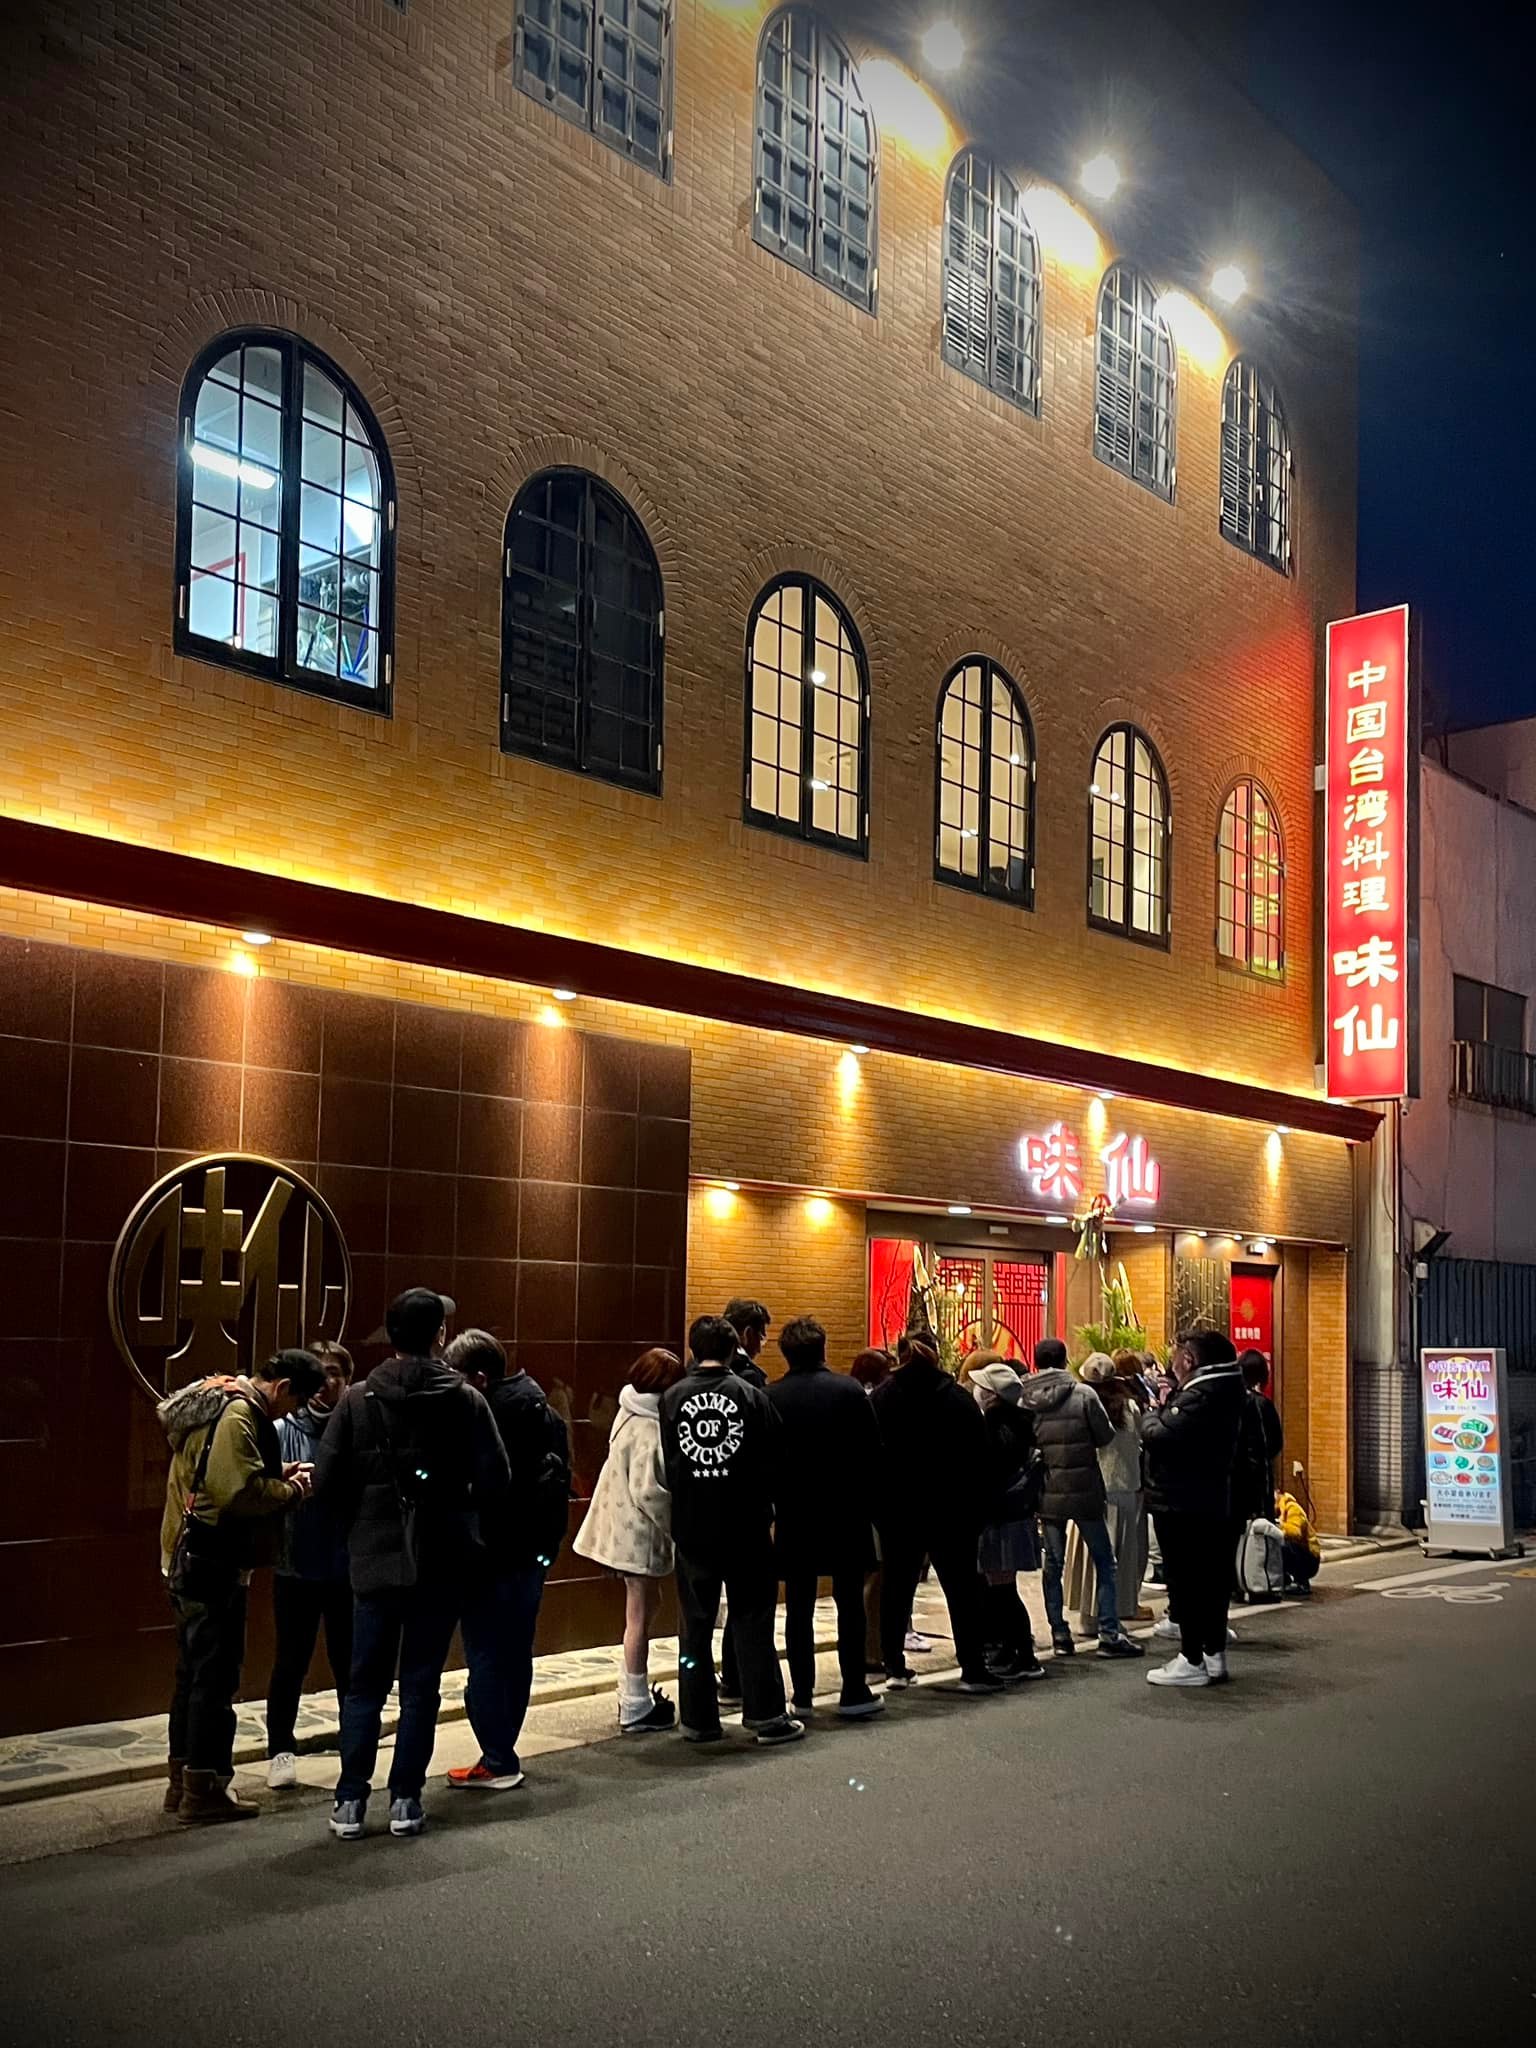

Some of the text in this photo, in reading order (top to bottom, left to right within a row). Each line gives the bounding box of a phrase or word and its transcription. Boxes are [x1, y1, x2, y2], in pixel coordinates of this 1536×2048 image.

[1332, 660, 1399, 1058] 中国台湾料理 味仙
[1019, 1122, 1160, 1204] 味仙
[681, 1391, 739, 1419] BUMP
[1432, 1378, 1488, 1400] 味仙
[677, 1419, 744, 1466] CHICKEN
[696, 1420, 721, 1438] OF
